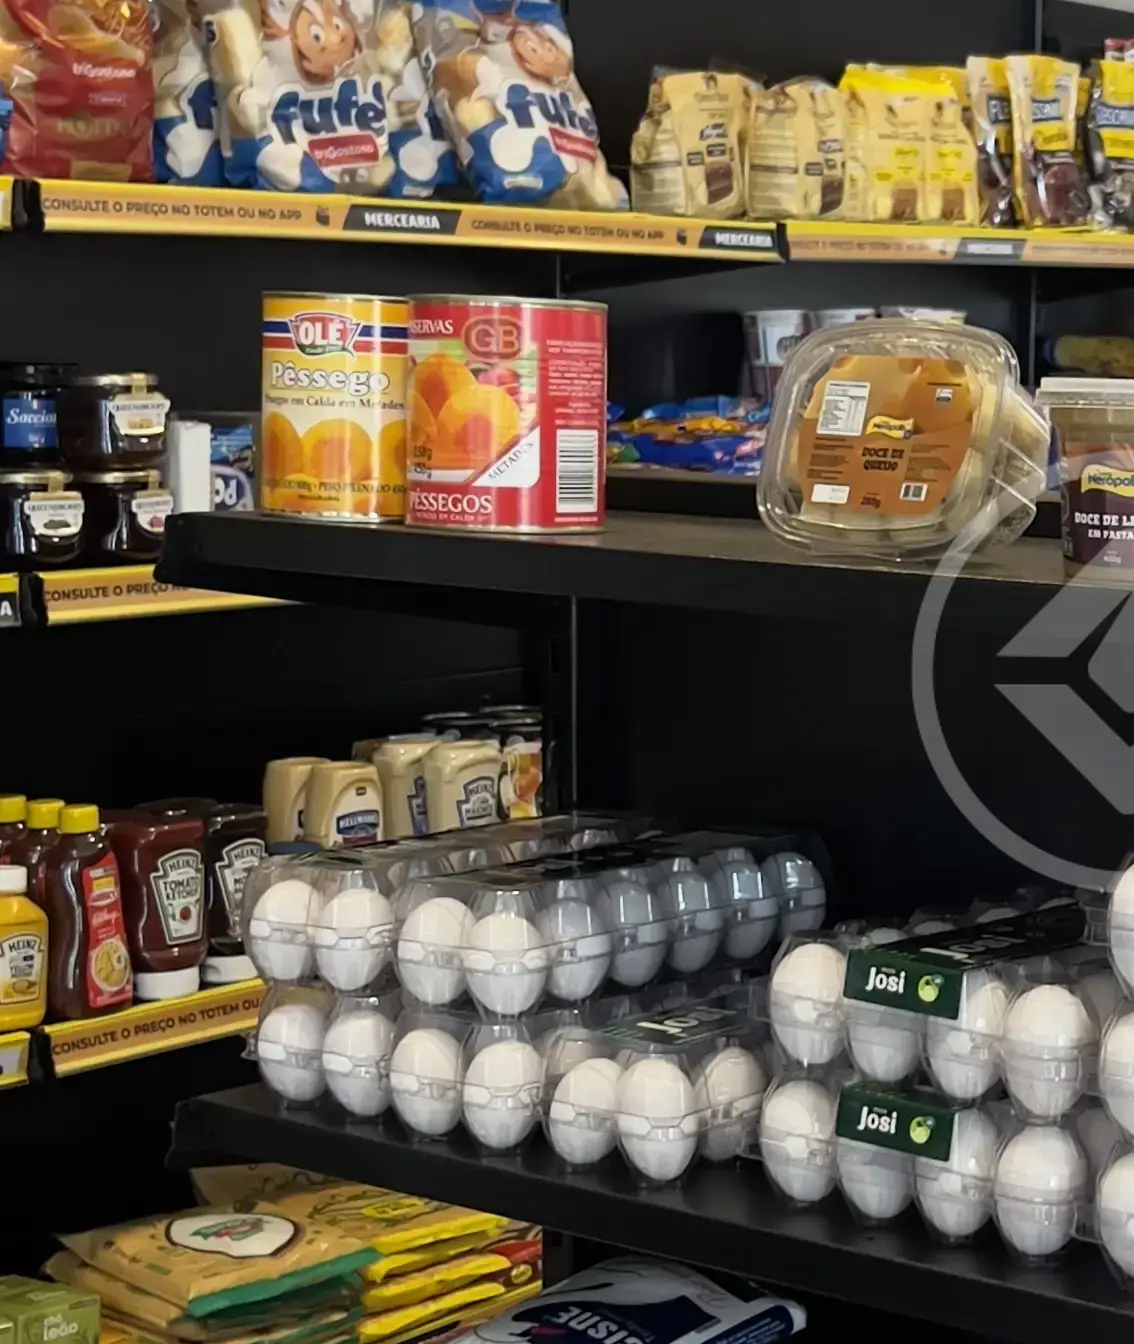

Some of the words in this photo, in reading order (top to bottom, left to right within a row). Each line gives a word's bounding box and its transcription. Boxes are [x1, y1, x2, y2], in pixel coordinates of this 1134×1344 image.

[42, 197, 110, 213] CONSULTE
[112, 200, 123, 213] O
[125, 201, 169, 216] PREÇO
[171, 202, 191, 216] NO
[193, 204, 235, 218] TOTEM
[238, 207, 256, 219] OU
[258, 208, 277, 220] NO
[279, 209, 303, 221] APP
[364, 212, 441, 230] MERCEARIA
[715, 231, 773, 248] MERCEARIA
[298, 315, 342, 346] OLÉ
[470, 323, 522, 353] GB
[271, 361, 391, 397] Pêssego
[306, 395, 337, 407] Calda
[1074, 511, 1101, 526] DOCE
[1102, 513, 1124, 527] DE
[1102, 530, 1134, 541] PASTA
[44, 584, 110, 602] CONSULTE
[112, 584, 122, 597] O
[168, 857, 198, 872] HEINZ
[163, 875, 200, 891] TOMATO
[7, 938, 38, 953] HEINZ
[865, 966, 906, 995] Josi
[52, 1030, 119, 1056] CONSULTE
[121, 1028, 131, 1040] O
[134, 1017, 176, 1036] PREÇO
[178, 1012, 197, 1028] NO
[200, 1001, 240, 1022] TOTEM
[242, 997, 260, 1011] OU
[857, 1106, 898, 1135] Josi
[43, 1322, 79, 1342] leão
